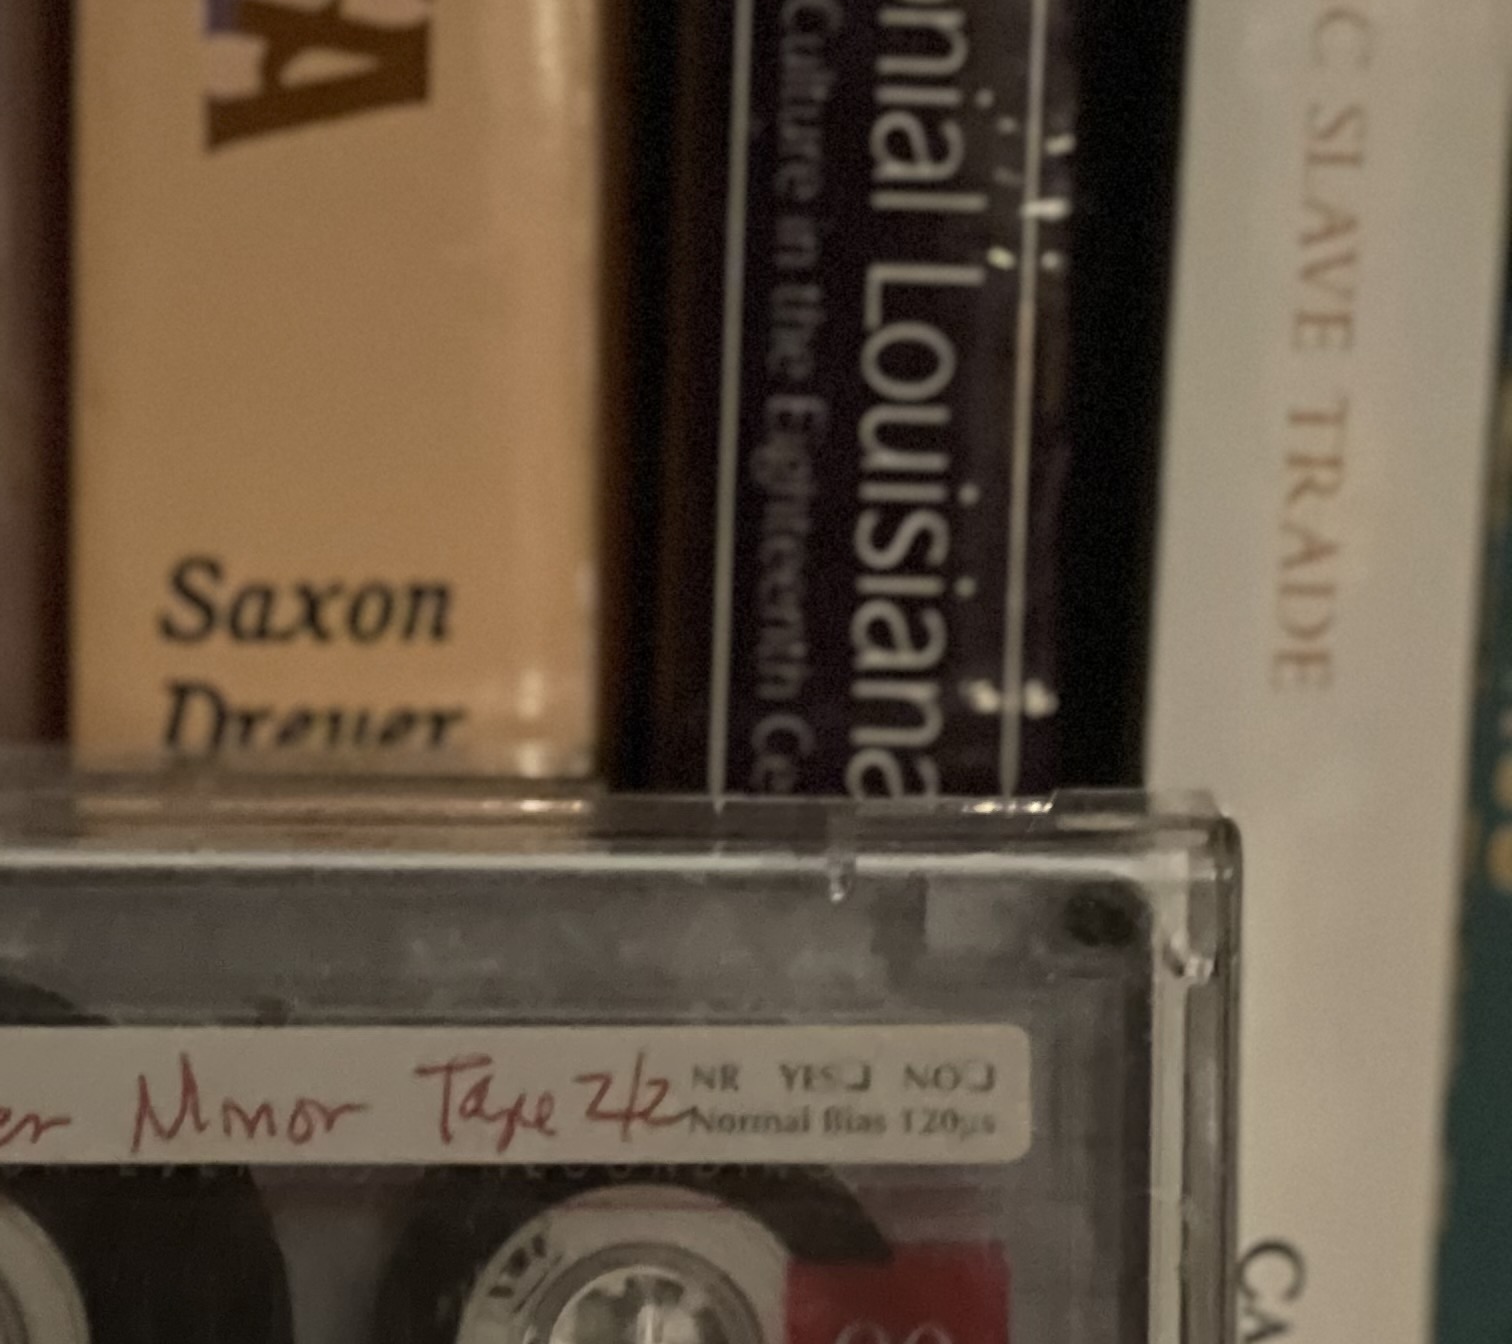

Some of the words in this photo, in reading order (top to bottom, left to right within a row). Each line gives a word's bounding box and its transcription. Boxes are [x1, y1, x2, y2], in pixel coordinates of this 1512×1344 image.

[772, 217, 832, 270] in
[1294, 103, 1369, 355] SLAVE
[767, 284, 827, 379] the
[845, 264, 987, 802] Louisiana
[1269, 395, 1351, 694] TRADE
[157, 555, 458, 646] Saxon
[688, 1105, 811, 1138] Normal
[822, 1105, 889, 1136] Bias
[691, 1065, 741, 1093] NR
[777, 1064, 836, 1094] YES
[903, 1065, 963, 1093] NO
